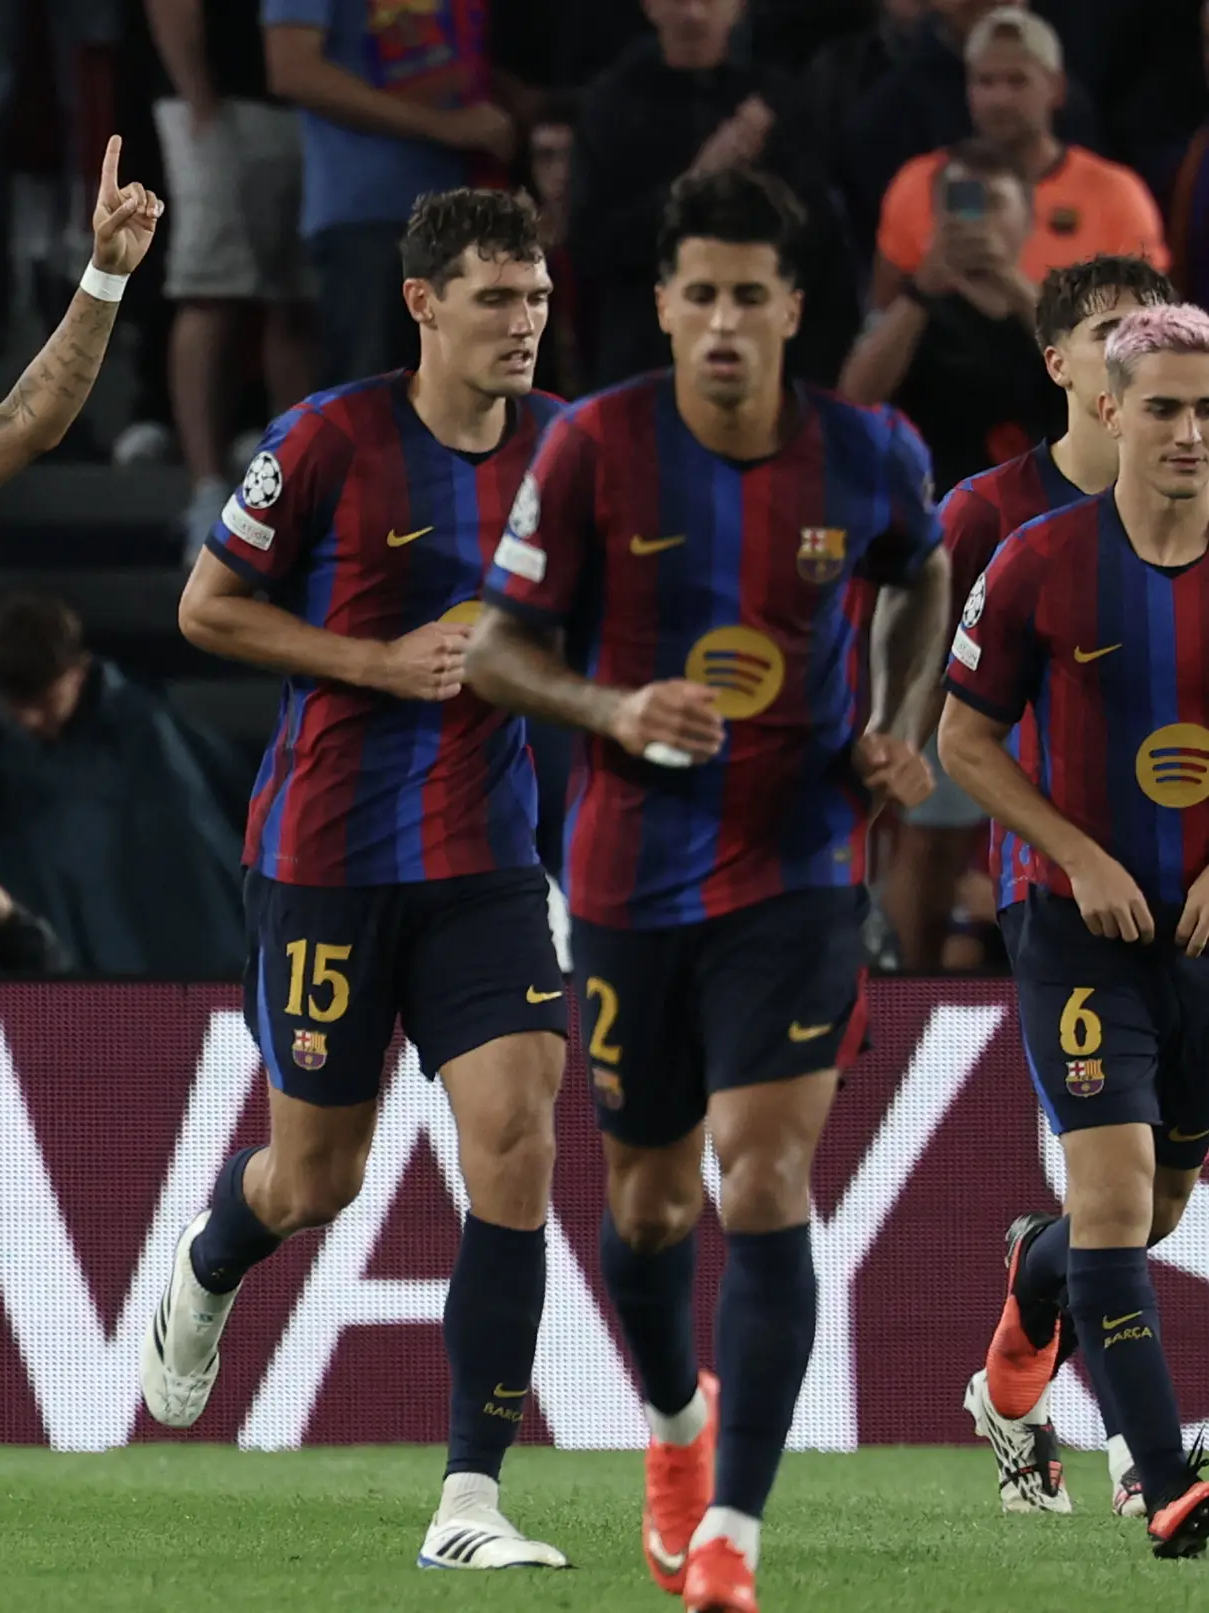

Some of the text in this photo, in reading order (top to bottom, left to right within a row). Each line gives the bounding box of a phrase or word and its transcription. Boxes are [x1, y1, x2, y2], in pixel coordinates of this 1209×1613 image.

[285, 938, 353, 1022] 15
[586, 976, 622, 1064] 2
[1060, 987, 1102, 1056] 6
[1104, 1326, 1153, 1349] BARÇA
